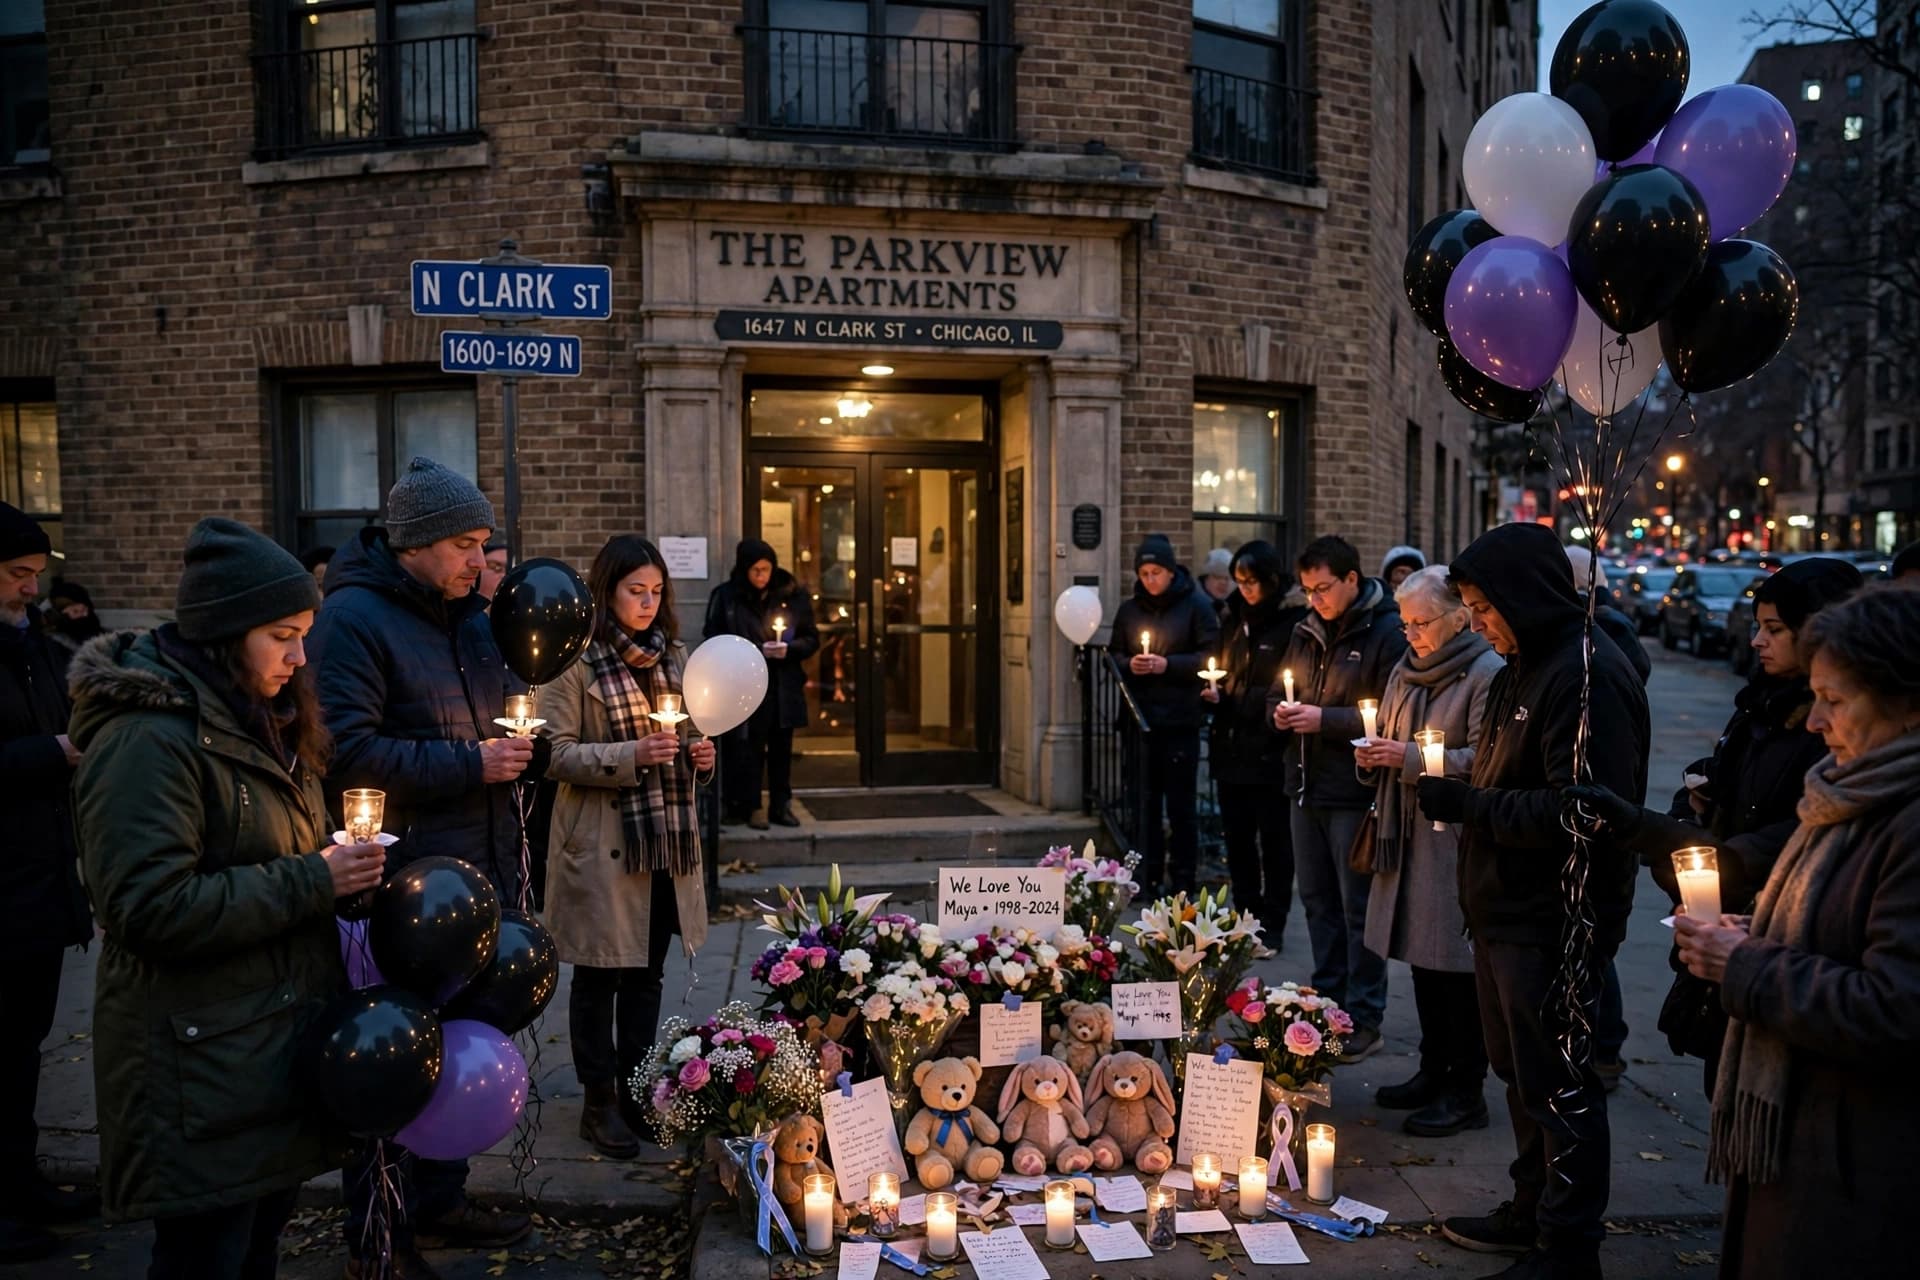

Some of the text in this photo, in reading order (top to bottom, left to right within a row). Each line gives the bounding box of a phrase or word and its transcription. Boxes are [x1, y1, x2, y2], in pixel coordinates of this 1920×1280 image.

[711, 231, 1069, 278] THE PARKVIEW
[422, 270, 600, 310] N CLARK ST
[764, 275, 1017, 311] APARTMENTS
[743, 317, 1038, 345] 1647 N CLARK ST CHICAGO, IL
[448, 338, 573, 369] 1600-1699 N
[950, 874, 1041, 894] We Love You
[944, 899, 1060, 921] Maya 1998-2024
[1134, 987, 1153, 998] Love
